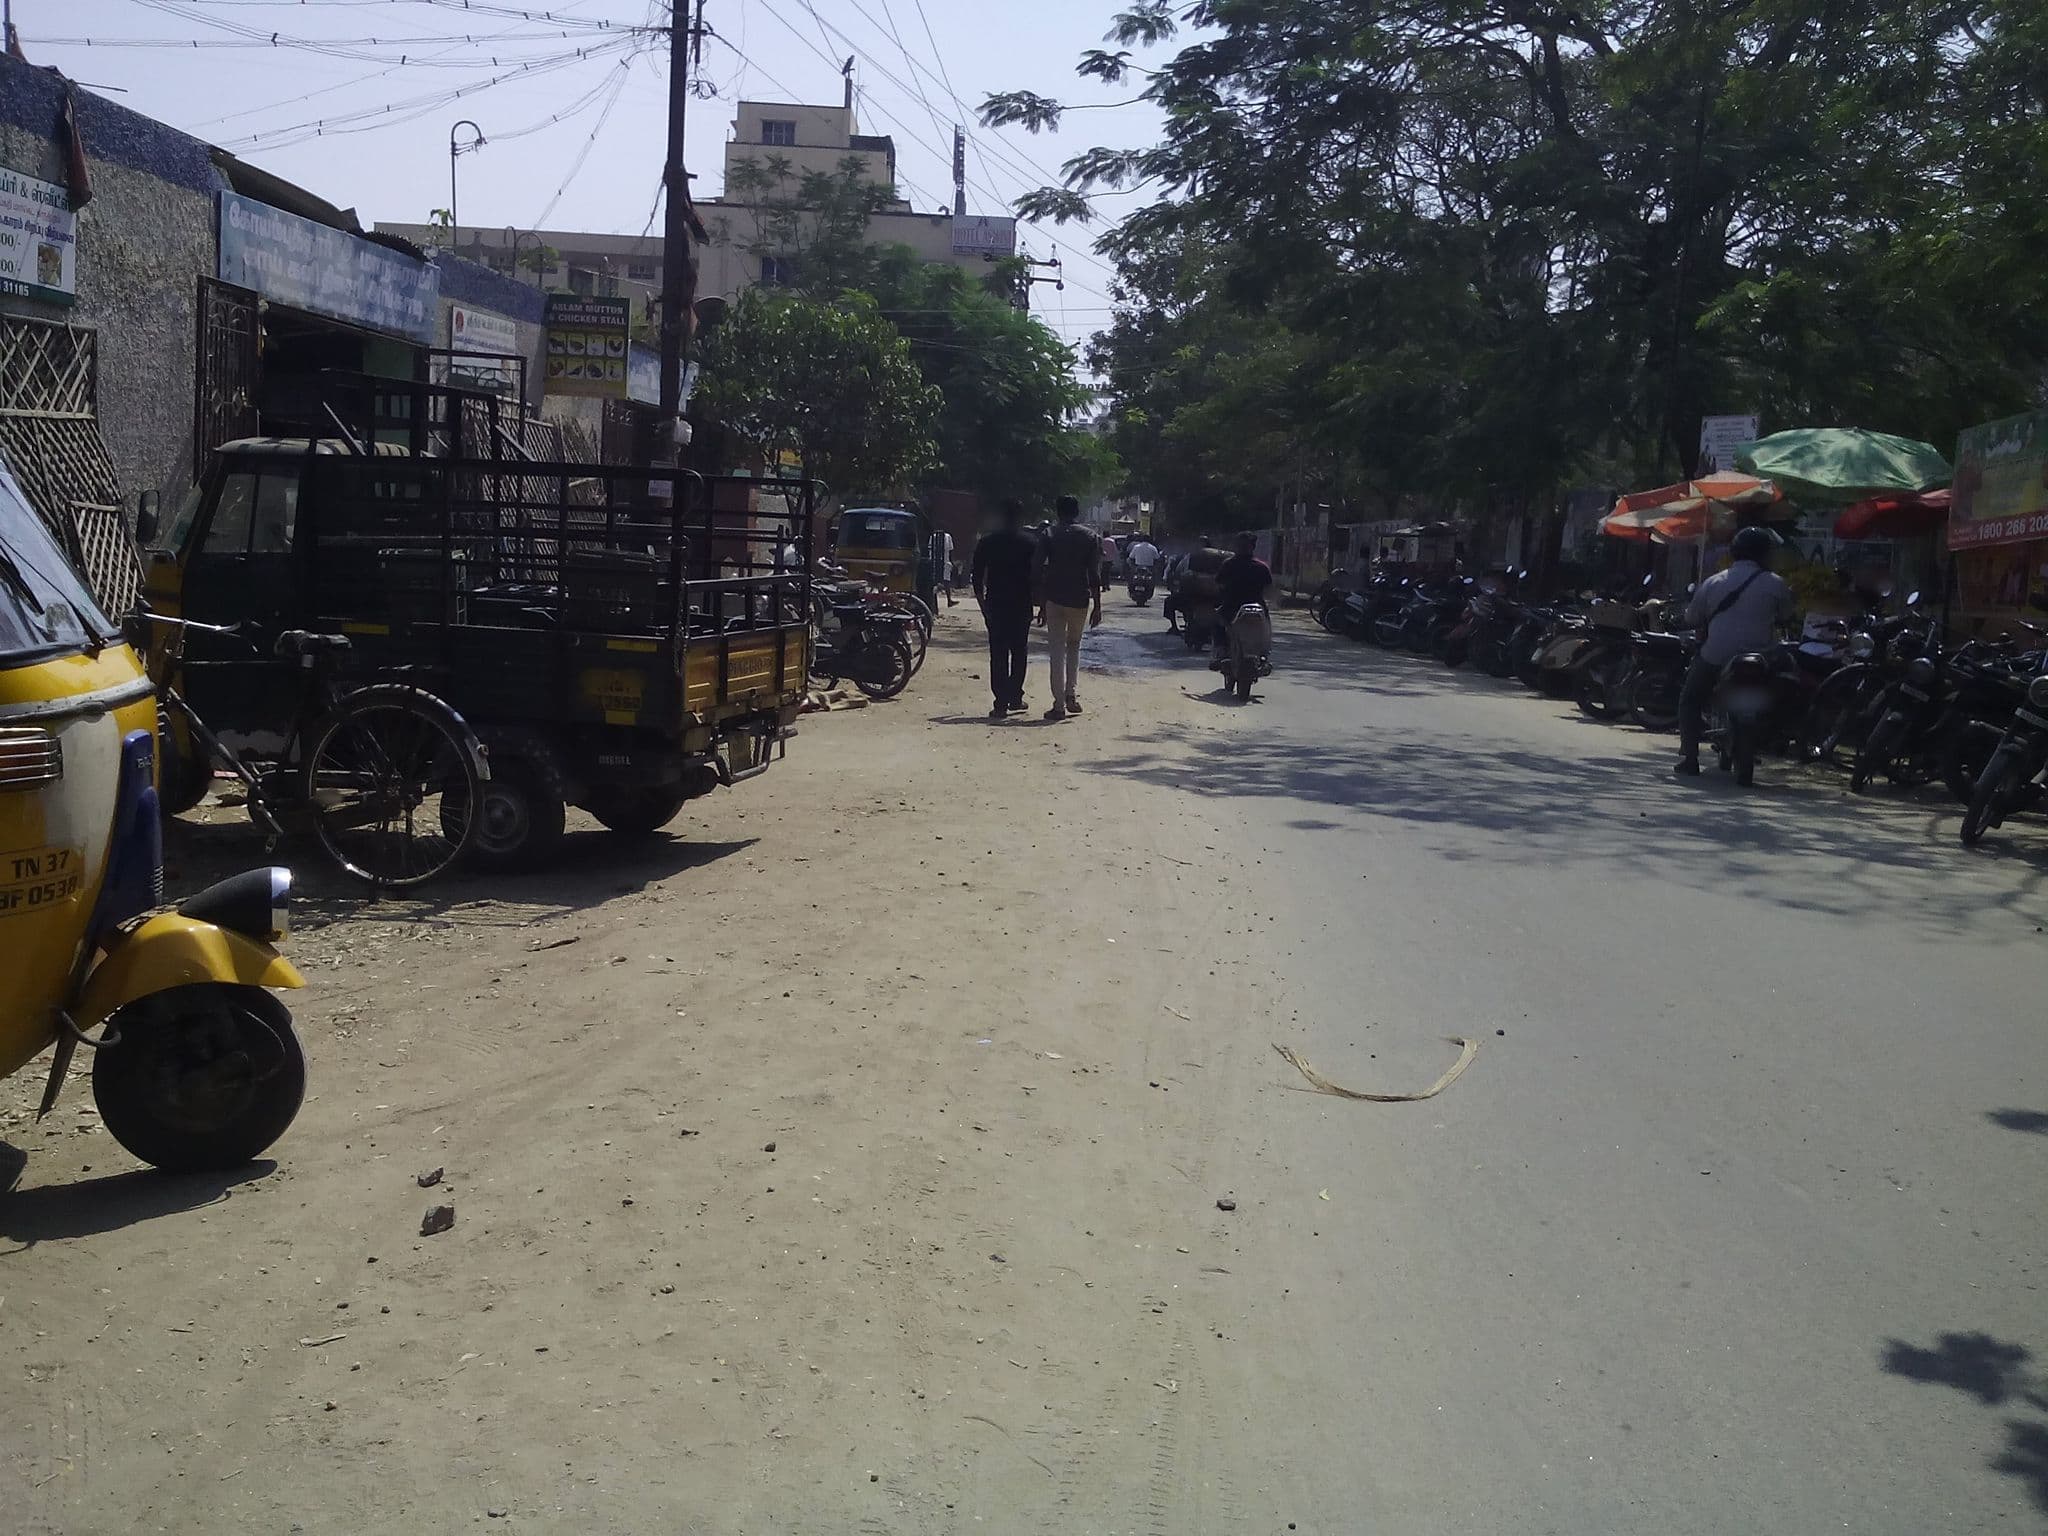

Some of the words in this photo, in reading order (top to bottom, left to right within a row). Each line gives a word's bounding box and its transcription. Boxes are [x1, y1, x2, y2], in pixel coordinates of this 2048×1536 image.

[20, 181, 28, 198] &
[585, 304, 624, 314] MUTTON
[558, 313, 598, 324] CHICKEN
[11, 855, 40, 879] TN
[46, 849, 70, 873] 37
